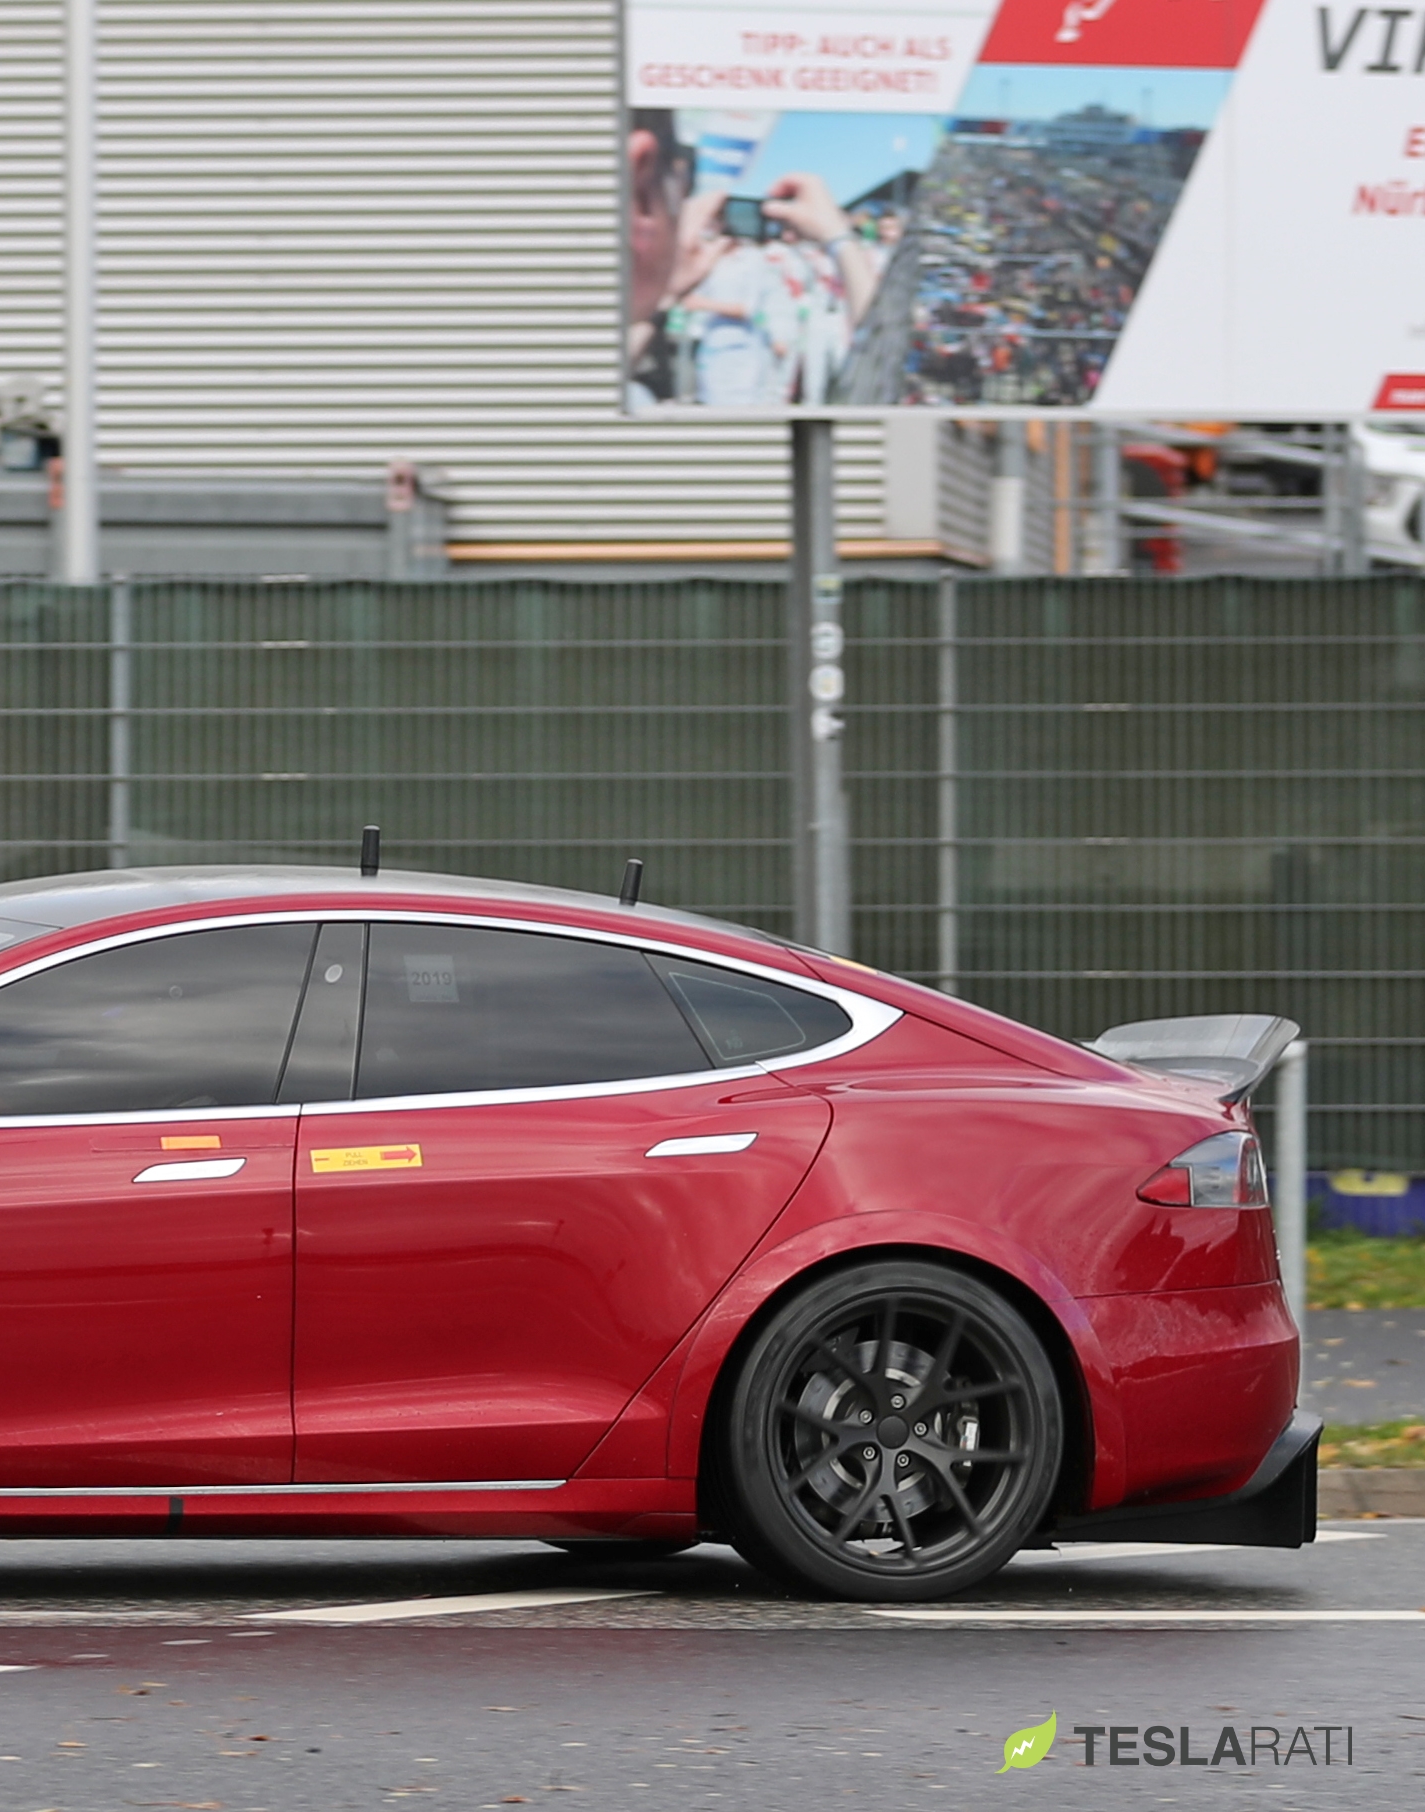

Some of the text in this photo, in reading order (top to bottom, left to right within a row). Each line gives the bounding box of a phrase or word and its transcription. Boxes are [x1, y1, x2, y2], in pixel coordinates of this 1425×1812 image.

[740, 31, 952, 60] TIPP: AUCH ALS
[640, 63, 784, 88] GESCHENK
[411, 971, 452, 986] 2019
